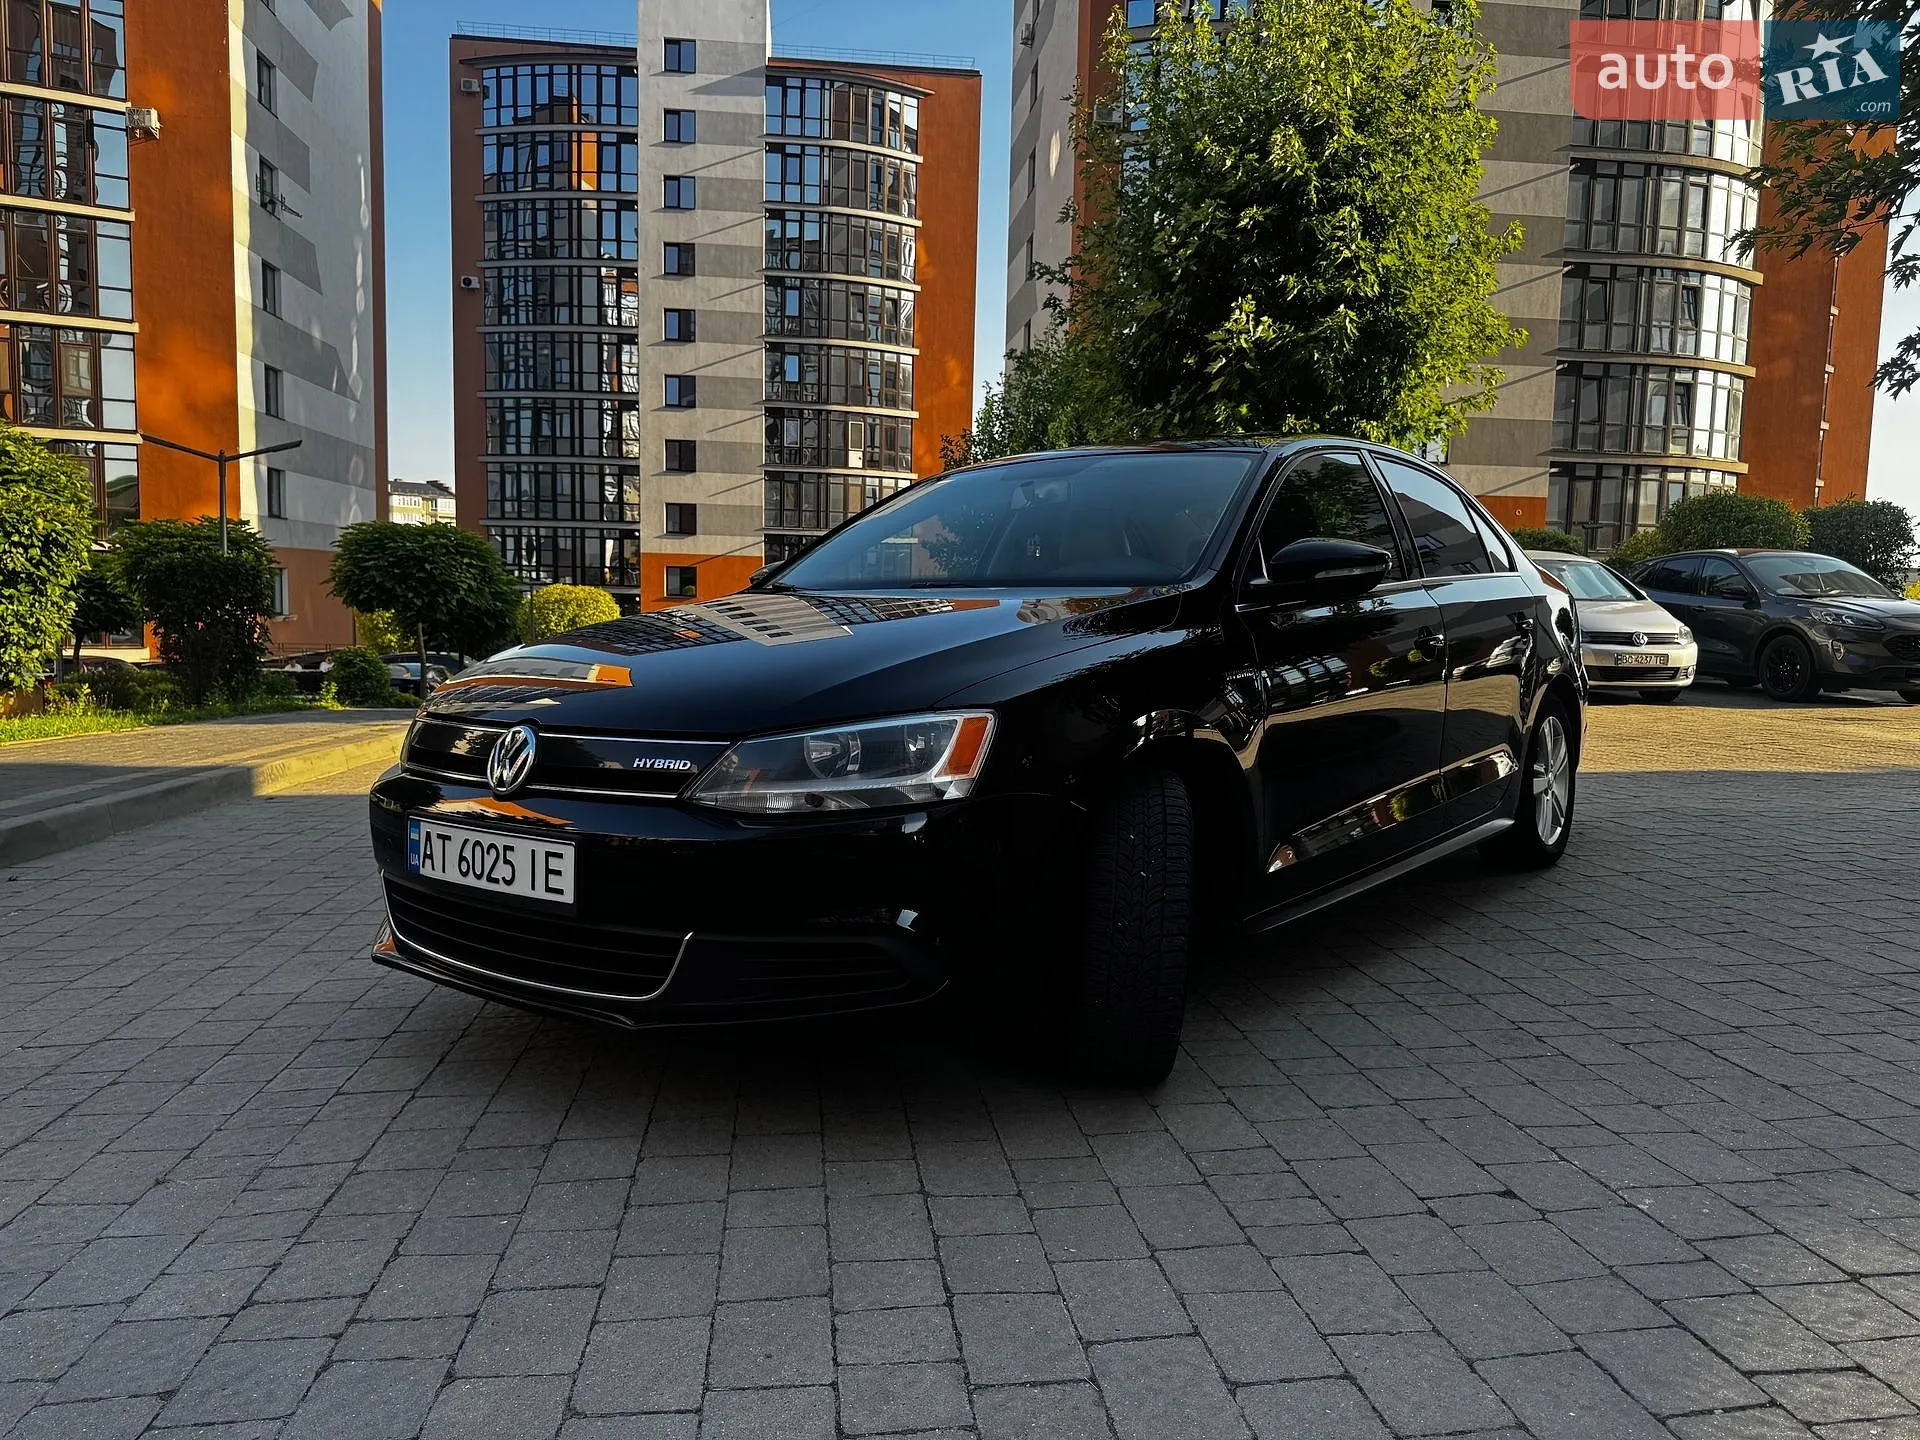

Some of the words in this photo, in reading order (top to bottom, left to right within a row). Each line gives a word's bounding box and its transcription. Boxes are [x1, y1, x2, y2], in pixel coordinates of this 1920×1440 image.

[632, 757, 692, 770] HYBRID
[410, 853, 420, 866] UA
[421, 829, 452, 873] AT
[457, 838, 516, 886] 6025
[530, 848, 565, 896] IE
